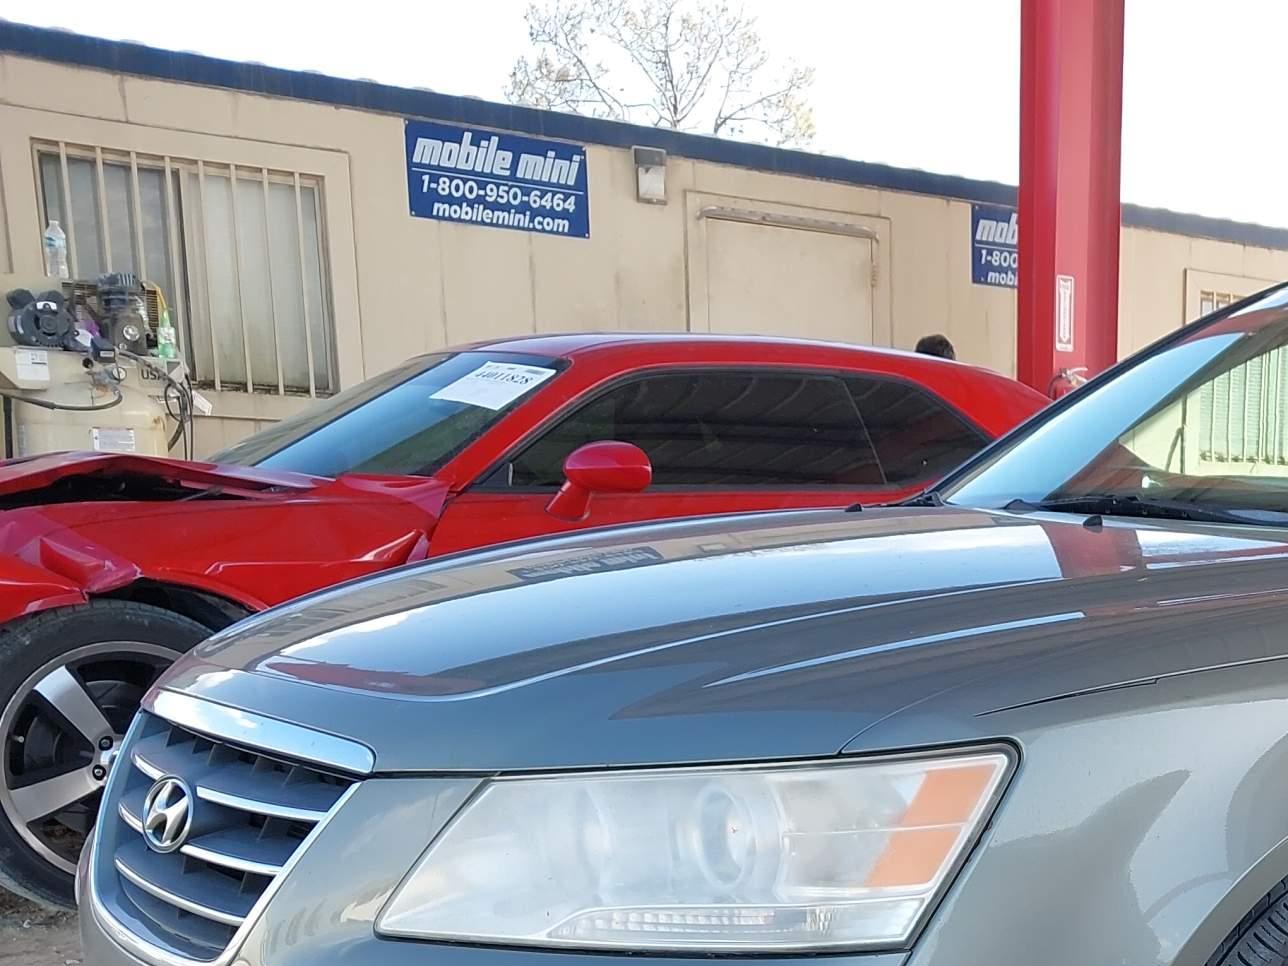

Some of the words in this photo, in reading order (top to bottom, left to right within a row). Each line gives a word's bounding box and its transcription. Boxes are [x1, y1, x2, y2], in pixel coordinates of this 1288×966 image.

[412, 131, 513, 176] mobile
[516, 150, 581, 186] mini
[421, 174, 576, 213] 1-800-950-6464
[432, 202, 569, 232] mobilemini.com
[975, 212, 1018, 245] mob
[981, 249, 1018, 268] 1-800
